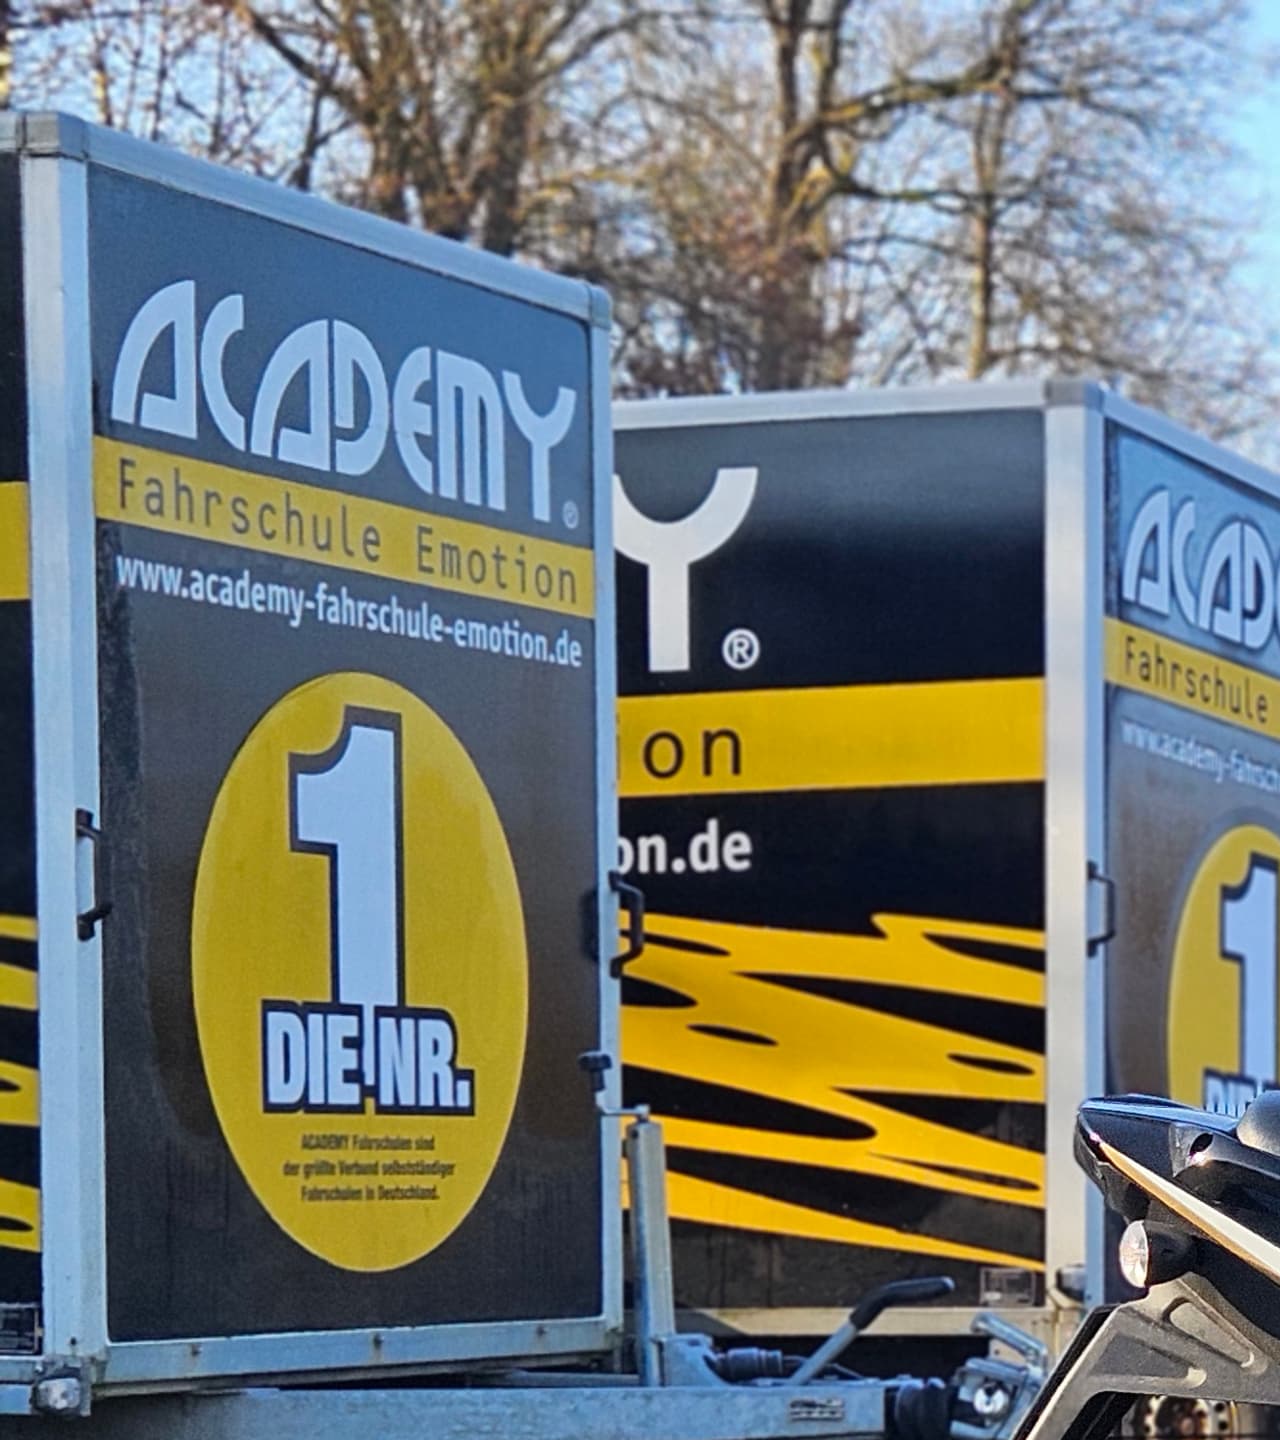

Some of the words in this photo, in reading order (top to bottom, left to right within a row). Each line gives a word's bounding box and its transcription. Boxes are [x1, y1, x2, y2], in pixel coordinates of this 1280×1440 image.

[112, 280, 576, 522] ACADEMY
[119, 457, 381, 563] Fahrschule
[416, 526, 577, 604] Emotion
[115, 555, 582, 668] www.academy-fahrschule-emotion.de
[1124, 635, 1269, 724] Fahrschule
[297, 724, 397, 1004] 1
[1224, 864, 1277, 1081] 1
[266, 1010, 361, 1105] DIE
[378, 1016, 471, 1107] NR.
